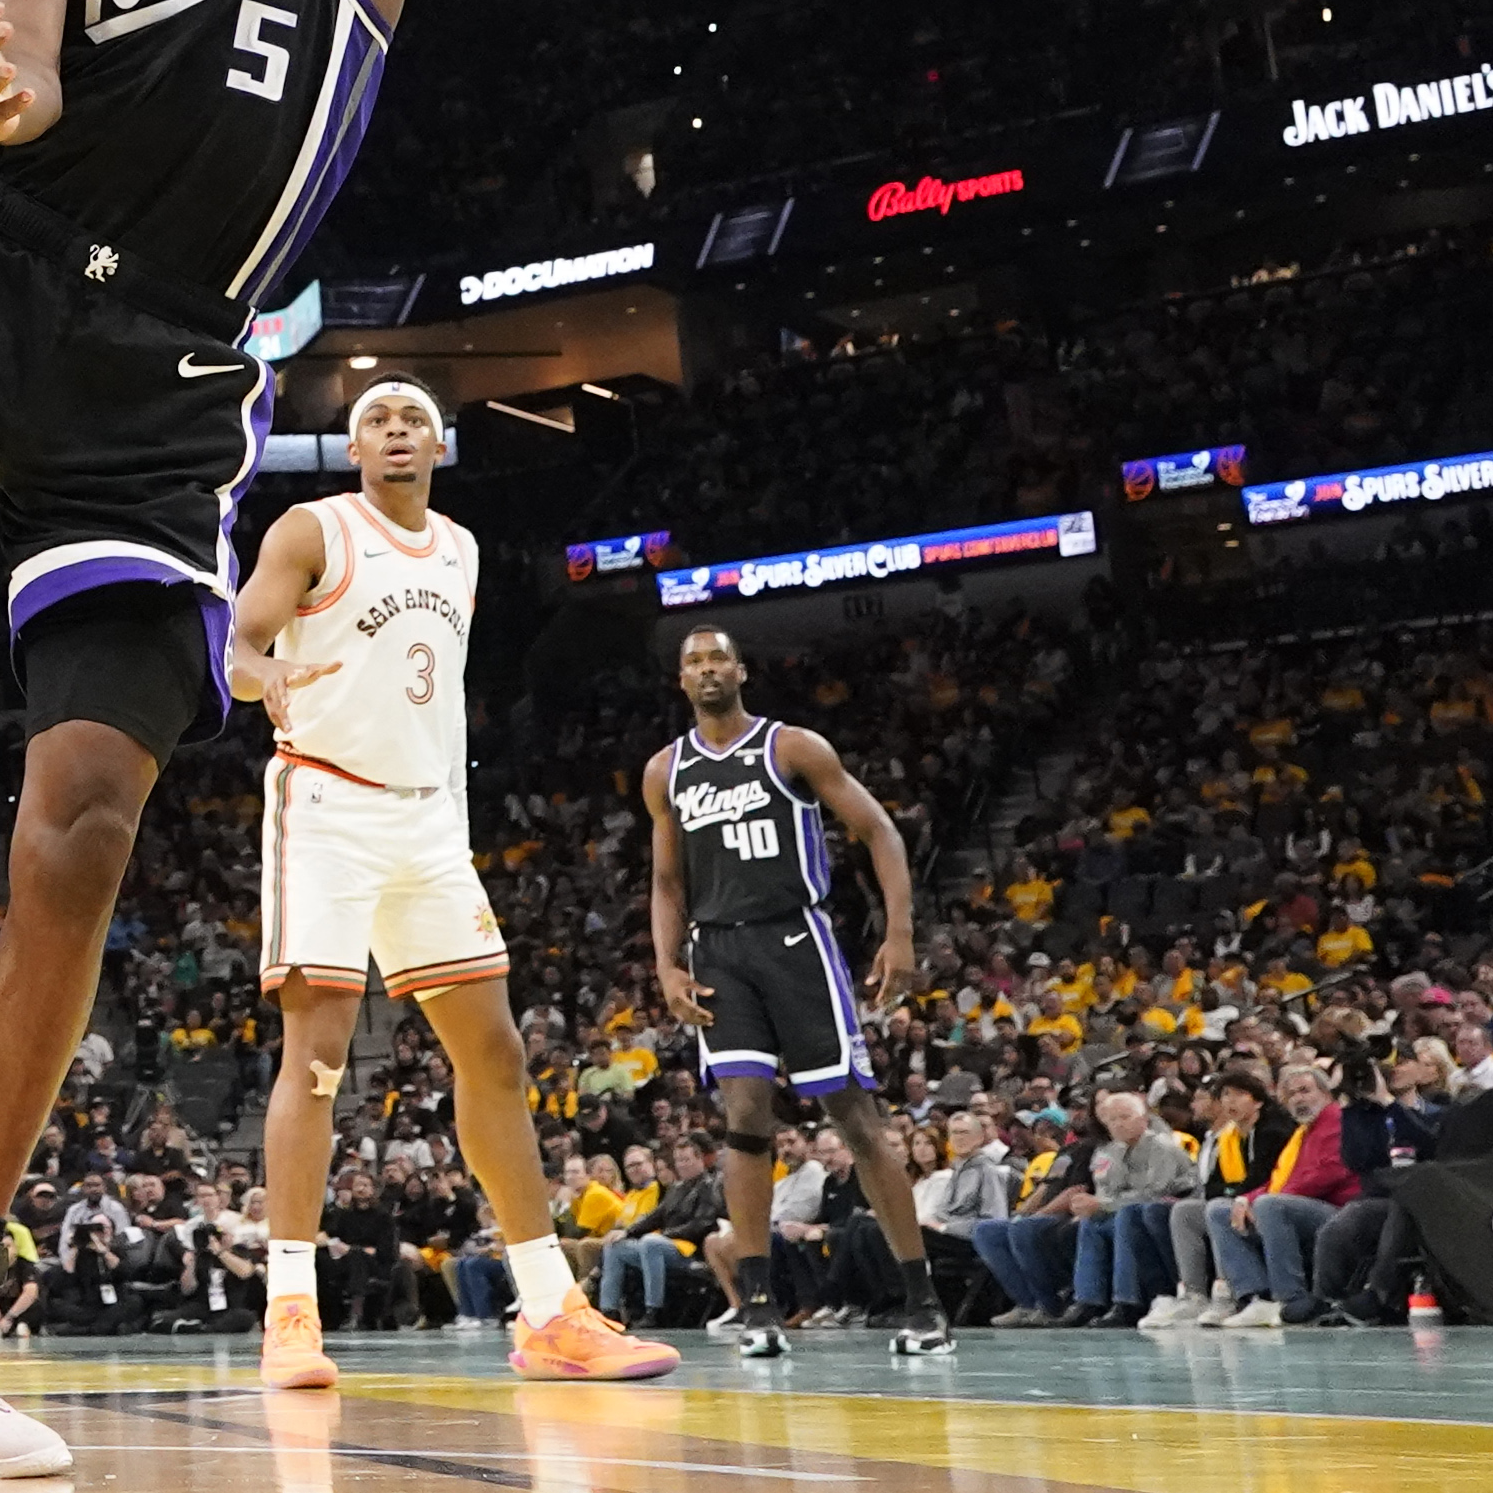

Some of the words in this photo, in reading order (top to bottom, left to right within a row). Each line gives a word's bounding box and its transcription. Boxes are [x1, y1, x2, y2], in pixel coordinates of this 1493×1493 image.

[1283, 96, 1370, 147] JACK
[869, 175, 956, 222] Bally
[957, 169, 1023, 201] SPORTS
[482, 243, 654, 301] DOCUMATION
[1342, 471, 1421, 511] SPURS
[738, 561, 803, 596] SPURS
[867, 543, 921, 578] CLUB
[357, 594, 401, 638] SAN
[406, 643, 435, 705] 3
[675, 780, 771, 832] Kings
[721, 819, 780, 861] 40
